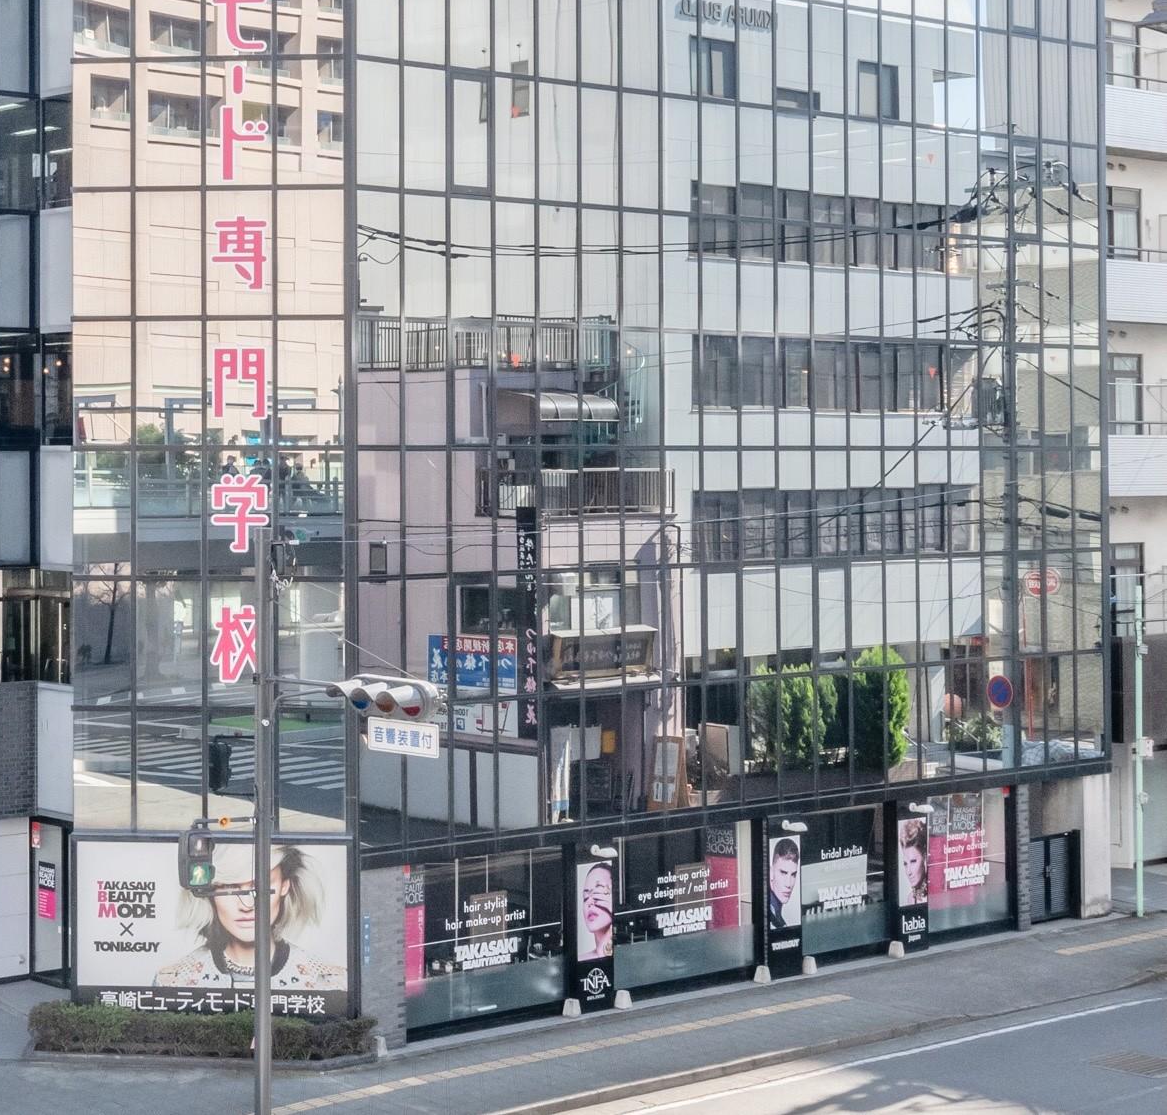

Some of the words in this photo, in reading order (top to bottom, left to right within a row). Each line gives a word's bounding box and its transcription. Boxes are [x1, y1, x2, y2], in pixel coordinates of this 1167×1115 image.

[374, 726, 432, 749] 音響装置付
[821, 847, 841, 860] bridal
[843, 845, 862, 857] stylist
[944, 844, 964, 854] beauty
[657, 871, 689, 885] make-up
[691, 868, 710, 879] artist
[944, 862, 990, 881] TAKASAKI
[97, 880, 156, 891] TAKASAKI
[638, 892, 651, 903] eye
[654, 887, 685, 899] designer
[694, 880, 707, 892] nail
[710, 879, 728, 890] artist
[818, 881, 868, 902] TAKASAKI
[97, 891, 155, 903] BEAUTY
[464, 901, 481, 913] hair
[484, 896, 508, 912] stylist
[97, 903, 156, 918] MODE
[656, 906, 713, 928] TAKASAKI
[445, 919, 463, 931] hair
[466, 914, 502, 927] make-up
[505, 910, 526, 921] artist
[902, 915, 926, 933] habia
[93, 941, 160, 952] TONI&GUY
[454, 937, 519, 962] TAKASAKI
[100, 990, 326, 1015] 高崎ビューティモード門学校
